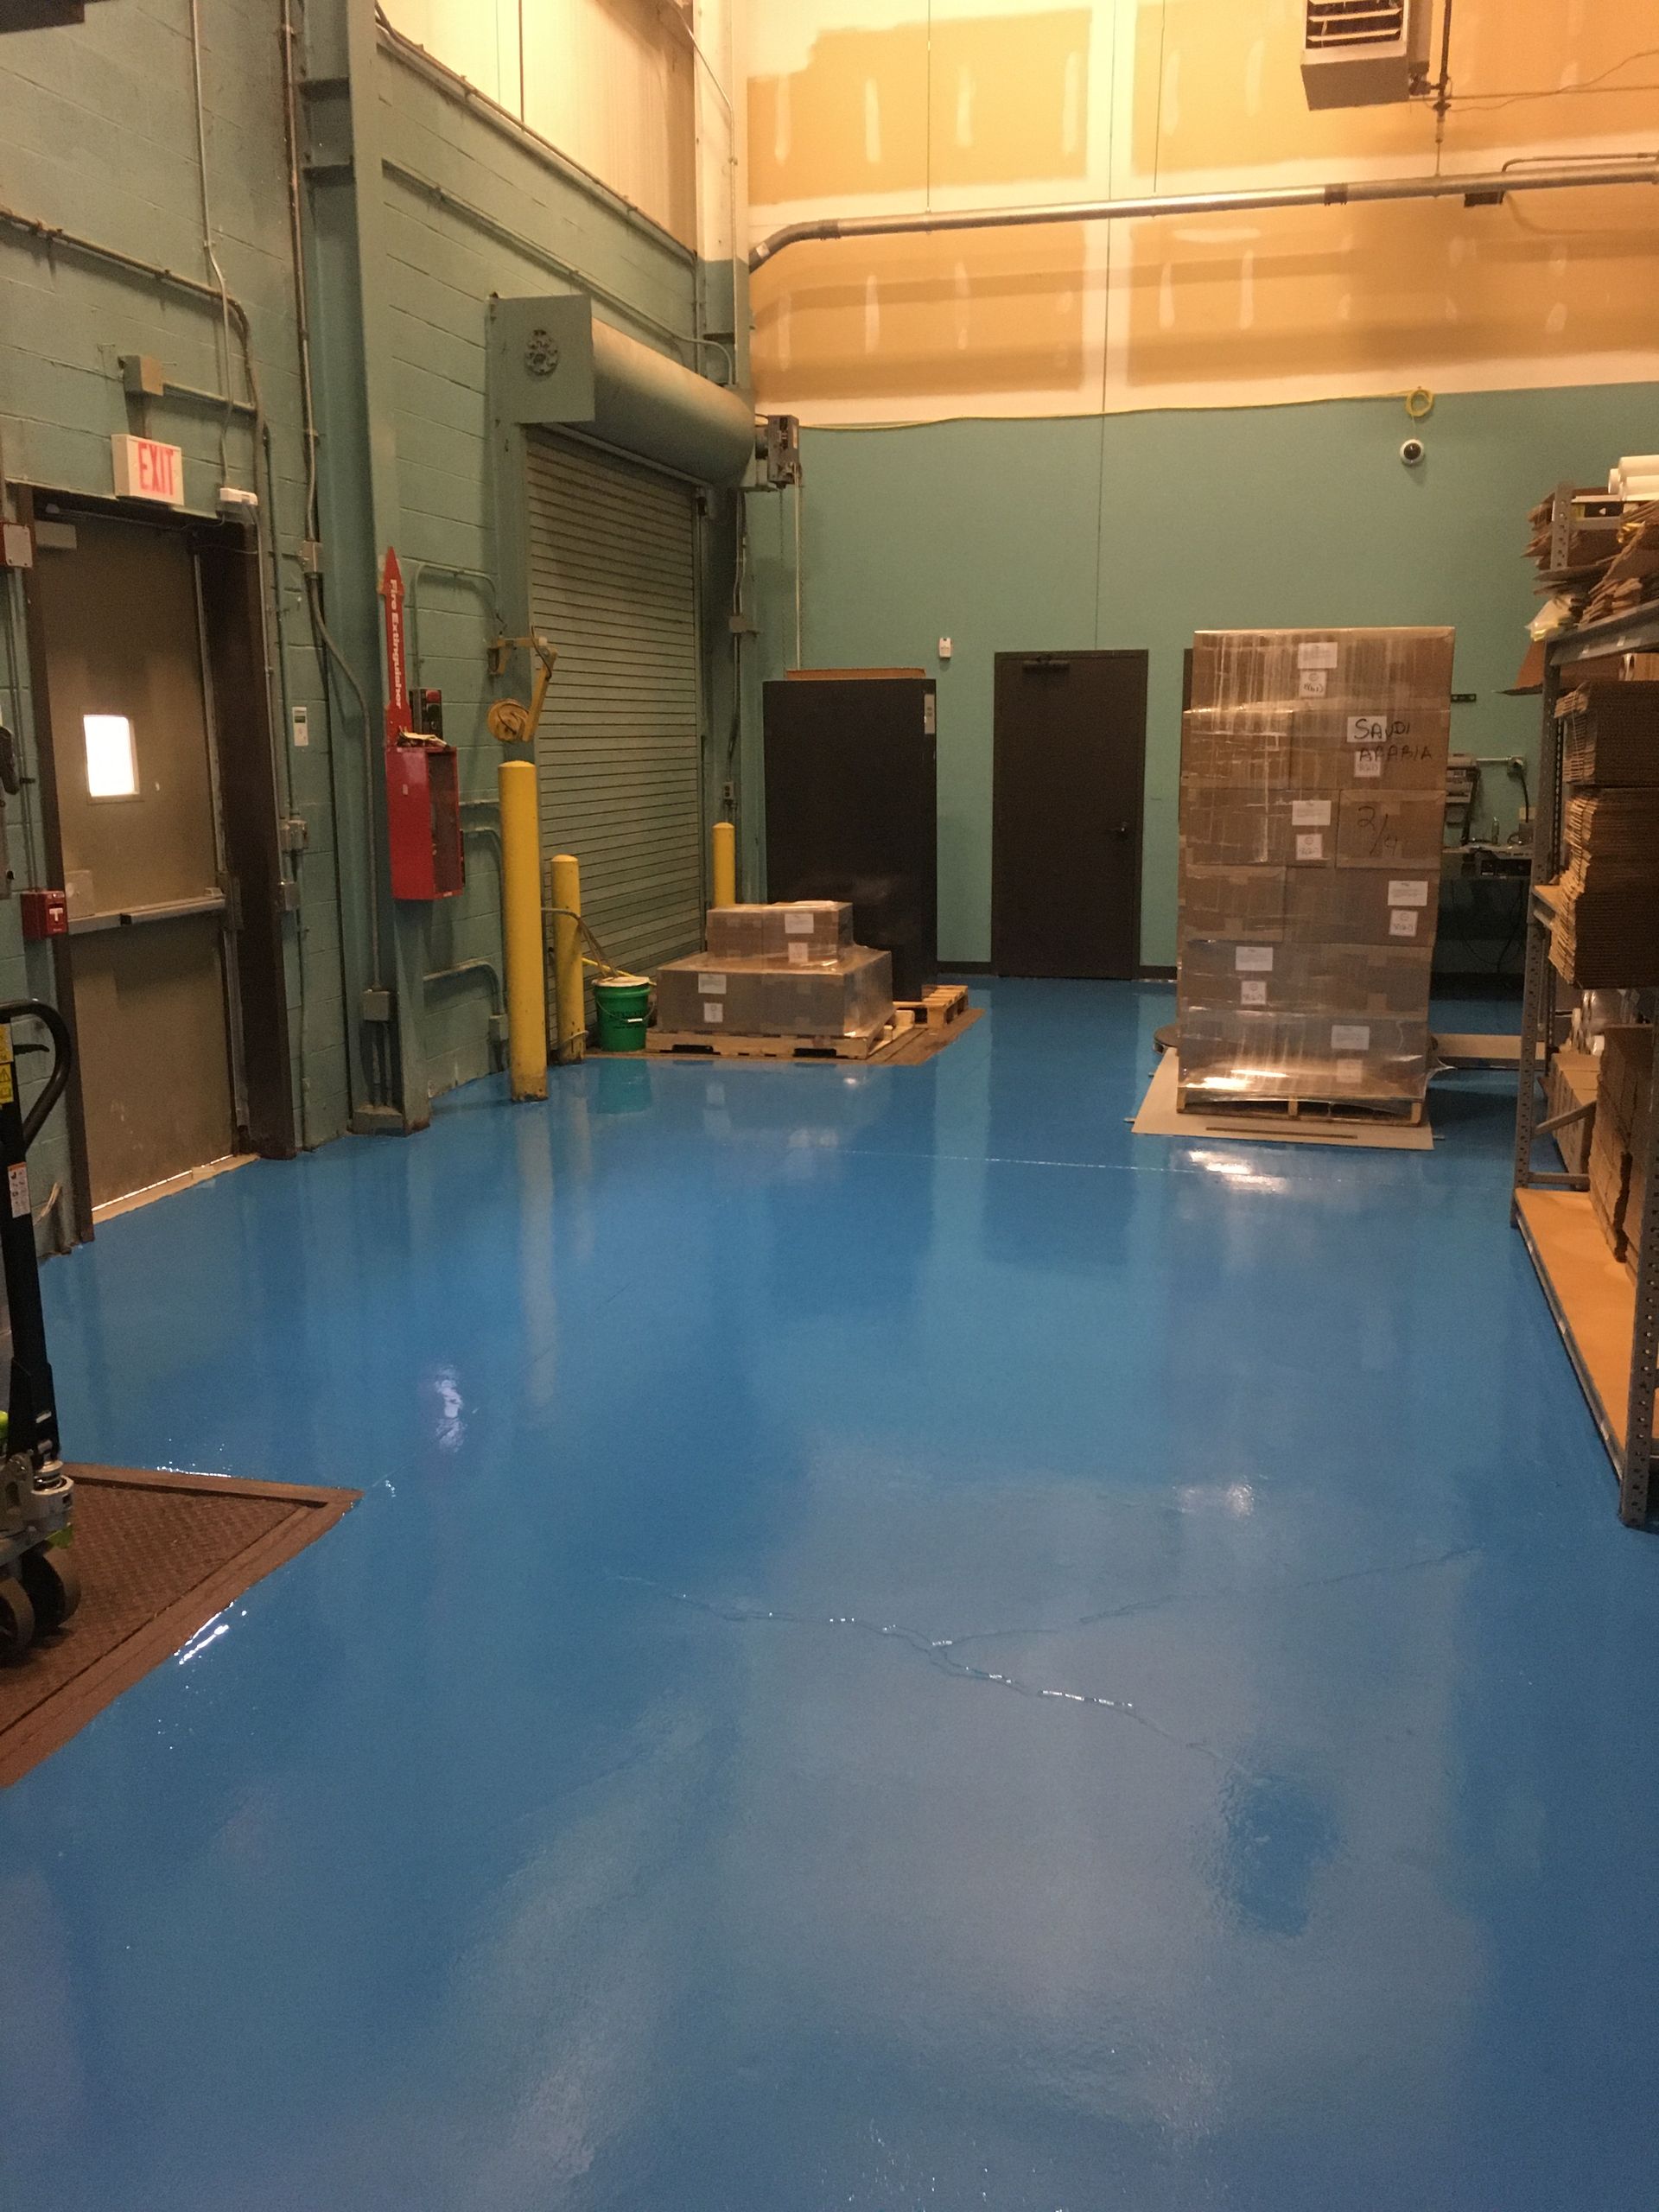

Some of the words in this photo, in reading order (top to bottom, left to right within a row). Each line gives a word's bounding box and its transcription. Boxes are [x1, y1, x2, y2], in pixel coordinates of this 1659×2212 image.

[138, 442, 174, 496] EXIT
[390, 579, 398, 610] Fire
[391, 612, 402, 709] Extinguisher
[1354, 718, 1410, 739] SAUDI
[1359, 744, 1432, 761] ARABIA
